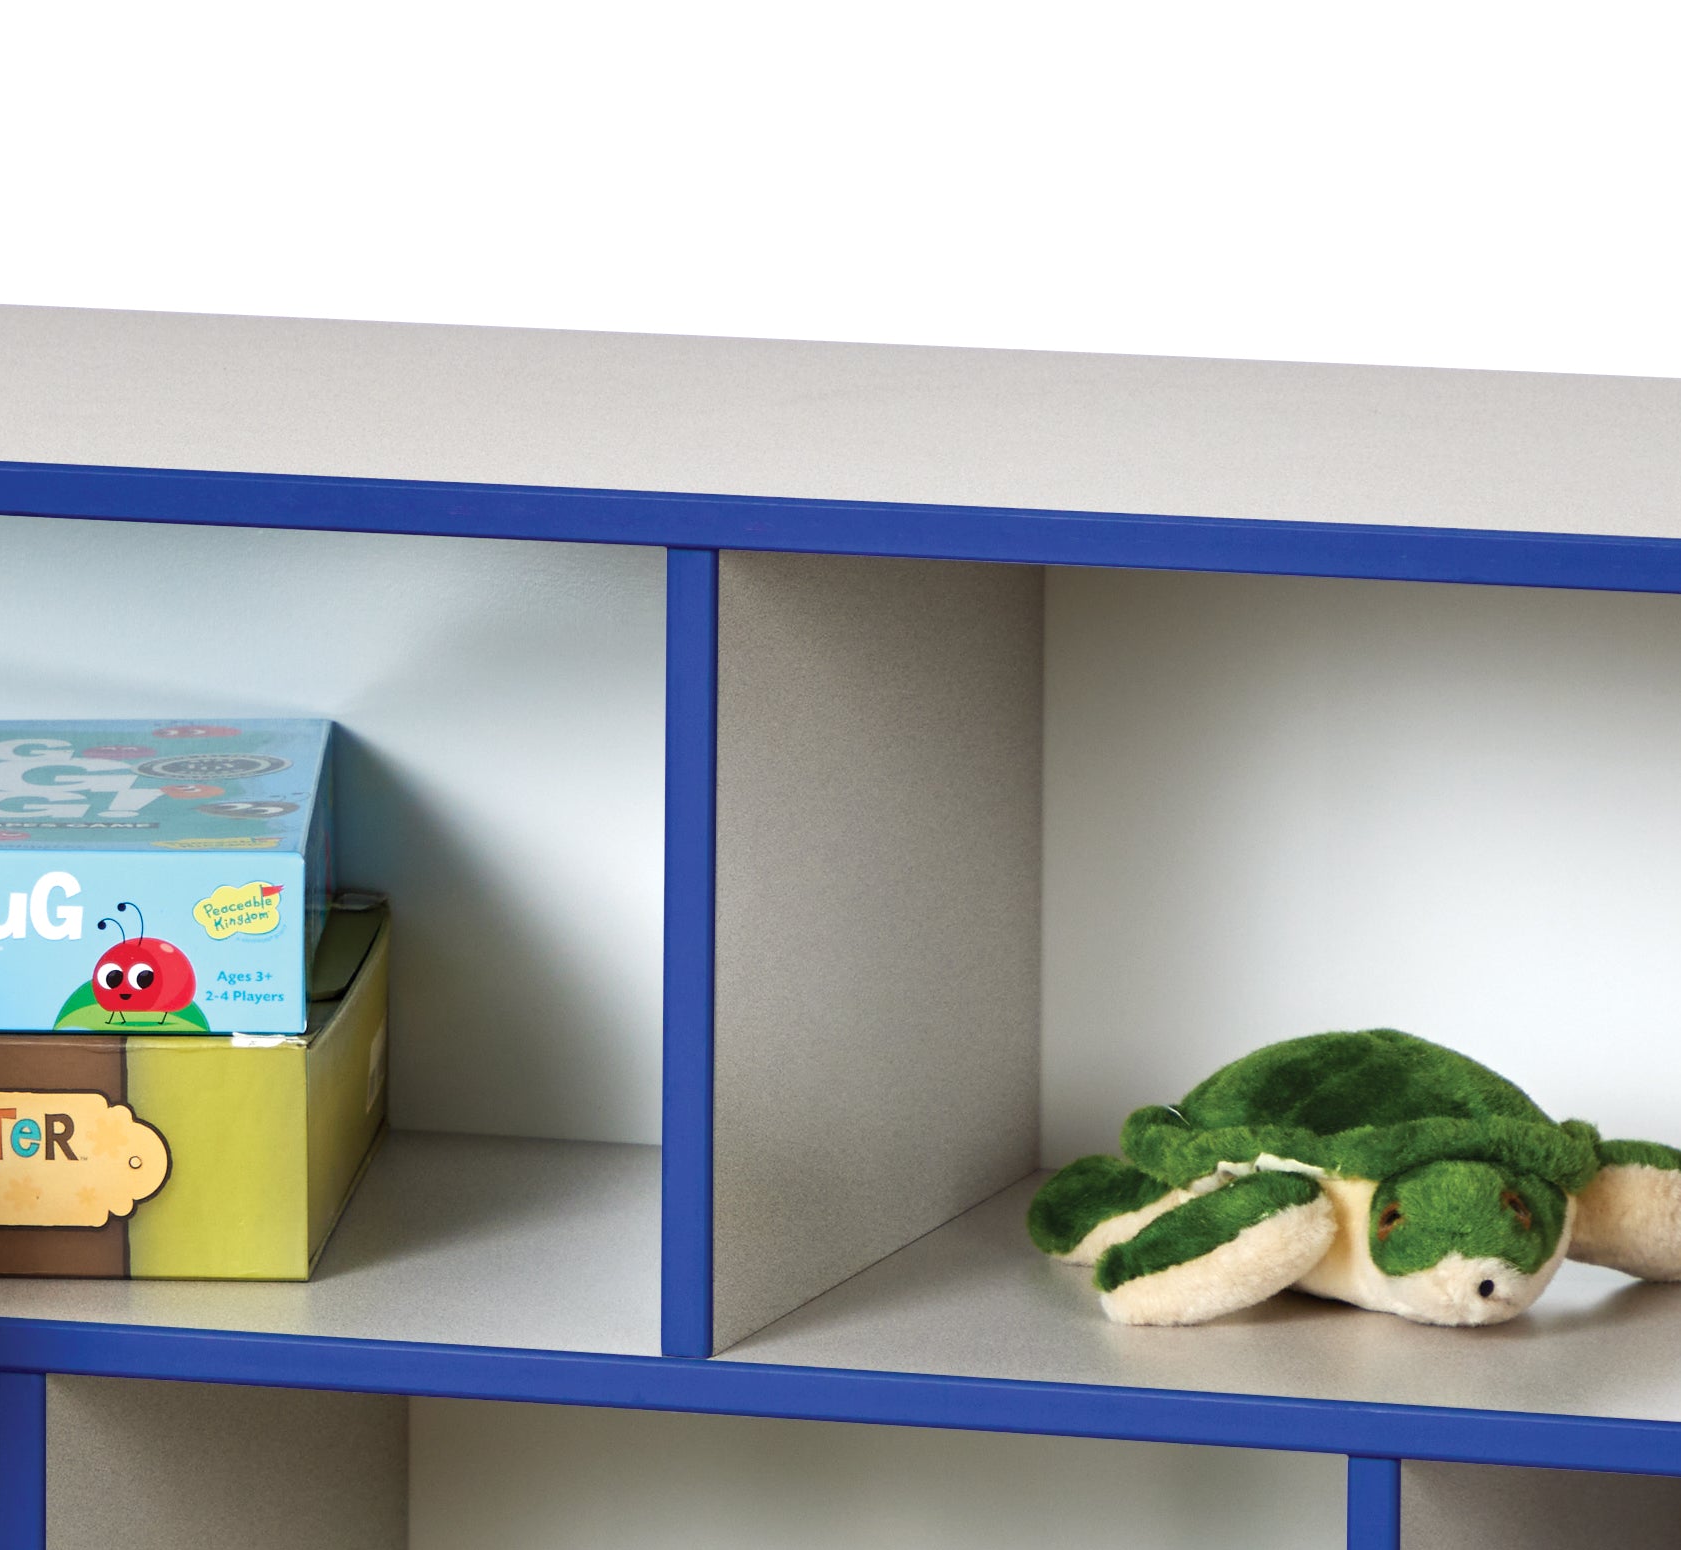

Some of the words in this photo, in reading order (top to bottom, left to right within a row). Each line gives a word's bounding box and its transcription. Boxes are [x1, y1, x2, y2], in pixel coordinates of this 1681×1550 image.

[203, 886, 273, 919] Peaceable
[214, 910, 270, 932] Kingdom
[217, 970, 252, 986] Ages
[255, 970, 273, 982] 3+
[205, 990, 229, 1001] 2-4
[233, 990, 285, 1005] Players
